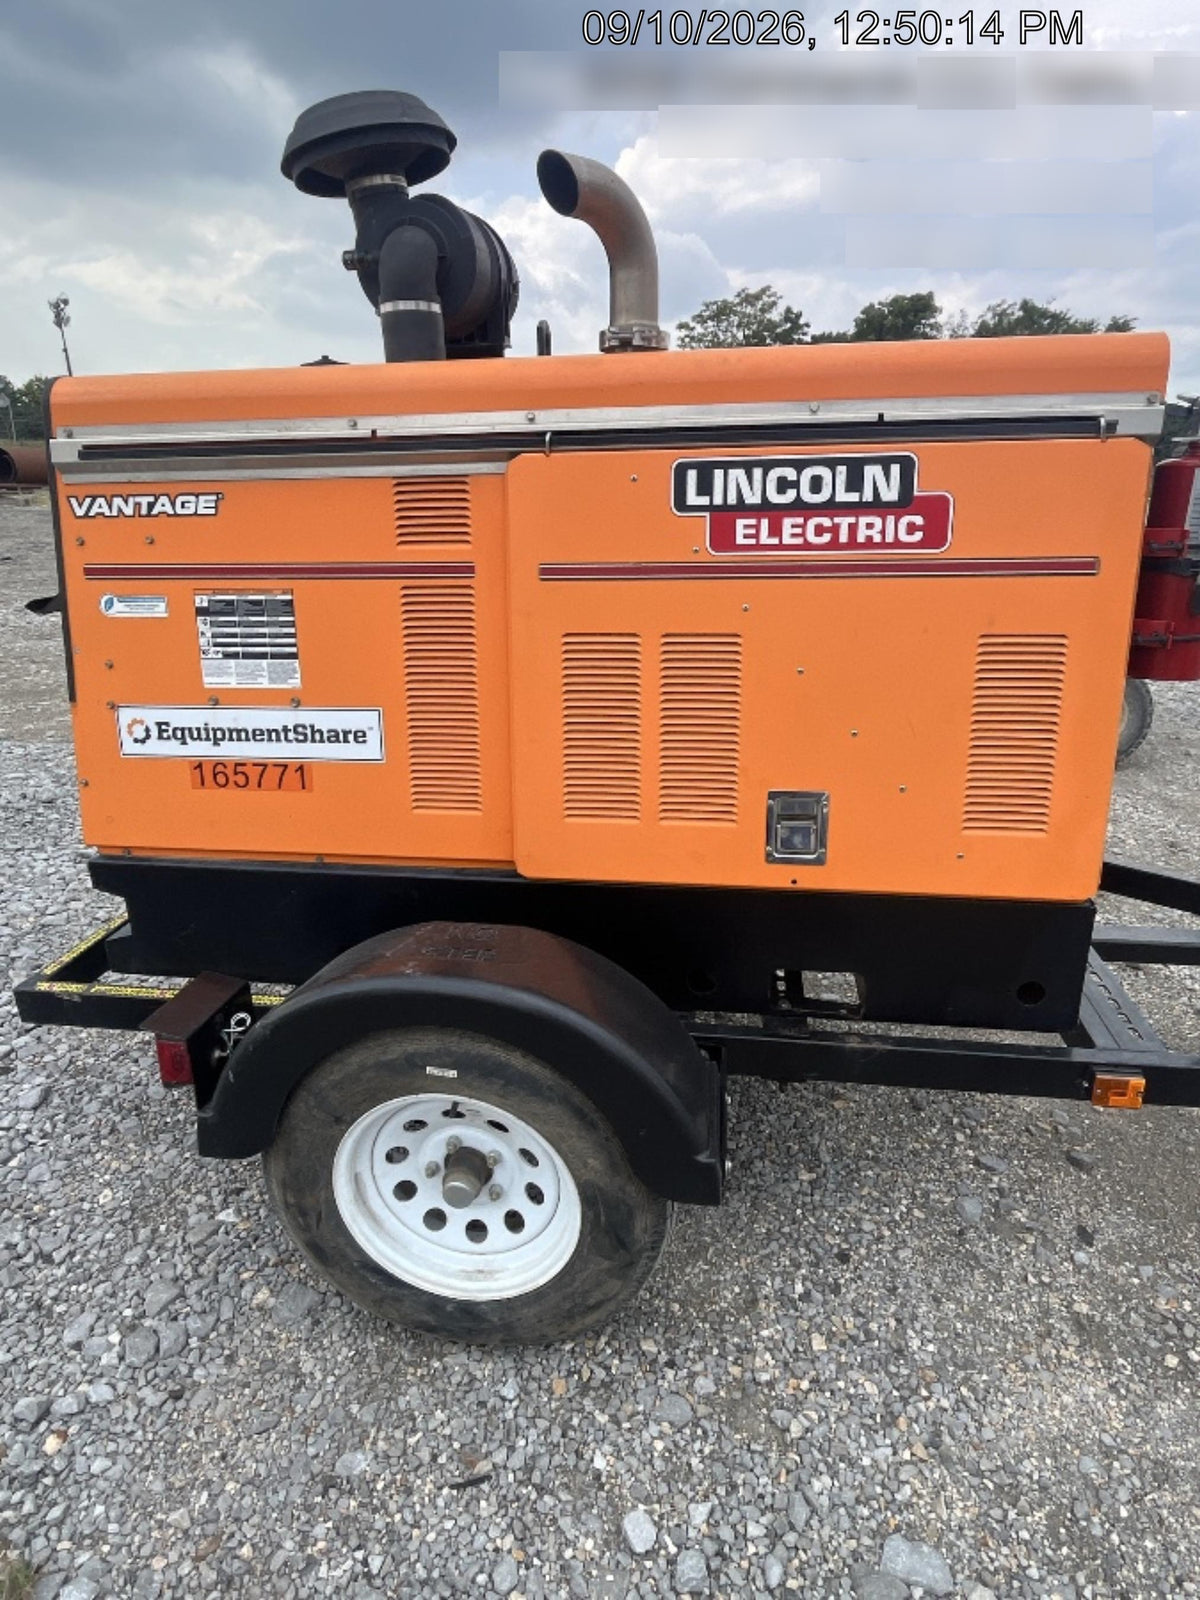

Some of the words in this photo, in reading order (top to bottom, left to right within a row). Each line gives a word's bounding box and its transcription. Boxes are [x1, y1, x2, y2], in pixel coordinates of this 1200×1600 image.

[685, 463, 901, 506] LINCOLN
[735, 514, 924, 546] ELECTRIC
[193, 762, 308, 790] 165771
